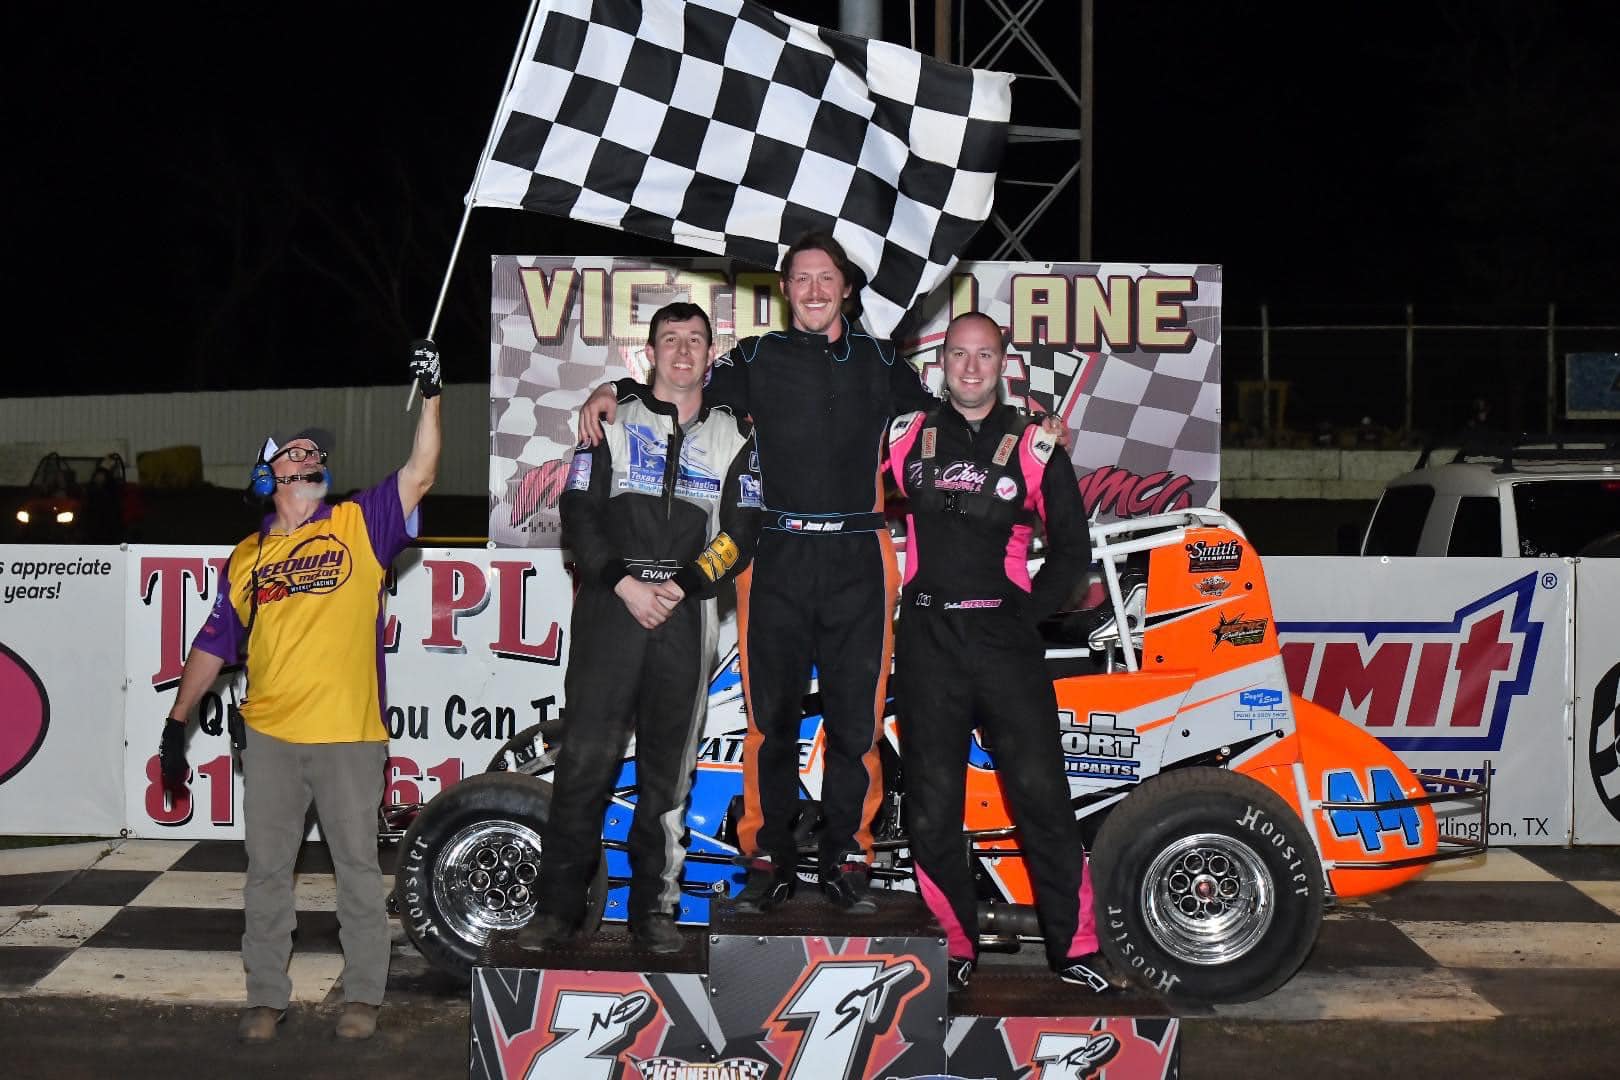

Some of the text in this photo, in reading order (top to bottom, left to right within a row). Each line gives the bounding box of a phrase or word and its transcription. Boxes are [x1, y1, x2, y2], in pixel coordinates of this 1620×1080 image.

[519, 267, 792, 346] VICTO
[1189, 540, 1237, 558] Smith
[11, 557, 111, 579] appreciate
[4, 581, 61, 603] years!
[387, 706, 429, 740] ou
[444, 694, 516, 741] Can
[1438, 817, 1549, 840] rlingon, TX
[1236, 806, 1309, 896] Hoosier
[1098, 905, 1181, 994] Hoosier
